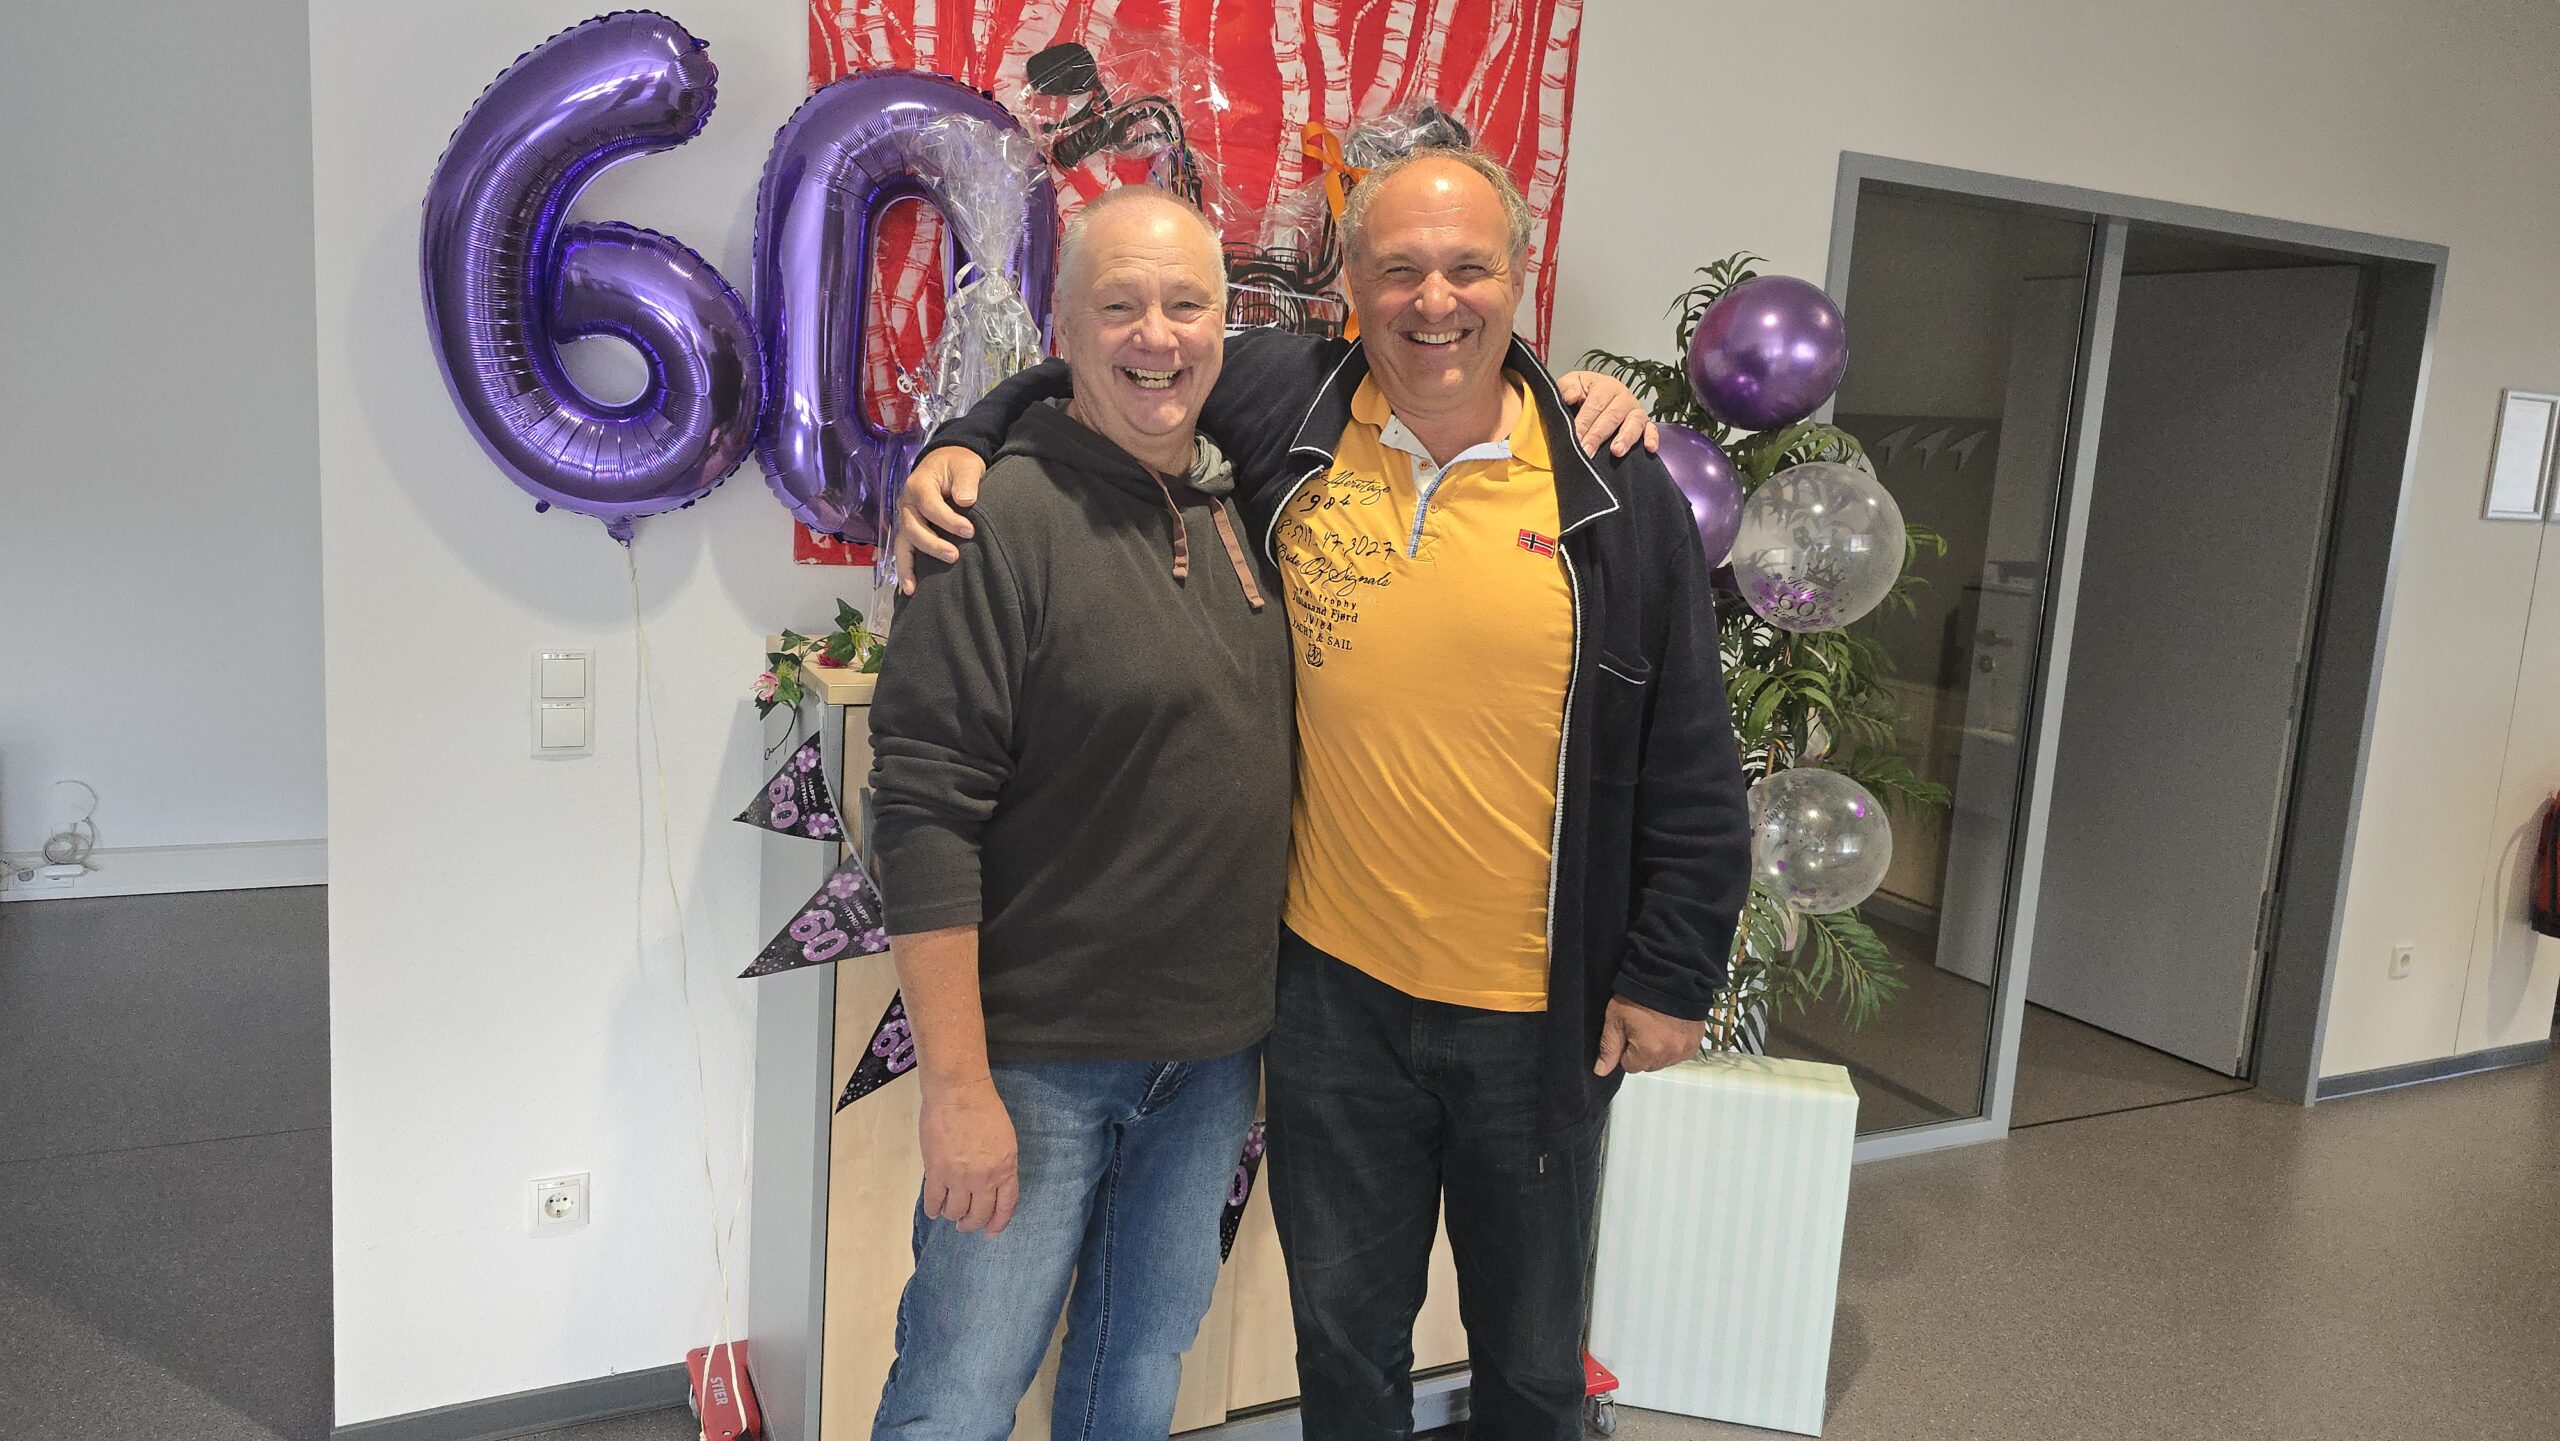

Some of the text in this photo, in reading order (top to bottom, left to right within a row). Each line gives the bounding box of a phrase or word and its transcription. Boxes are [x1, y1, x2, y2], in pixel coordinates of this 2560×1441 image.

[419, 12, 1058, 546] 60
[1297, 490, 1351, 512] 1984
[1321, 562, 1392, 597] Signals
[1318, 594, 1358, 610] trophy
[1778, 592, 1816, 617] 60
[1315, 633, 1324, 643] &
[1327, 636, 1353, 651] SAIL
[768, 775, 799, 829] 60
[808, 777, 818, 807] HAPPY
[853, 900, 872, 925] HAPPY
[789, 909, 849, 962] 60
[872, 1018, 916, 1073] 60
[710, 1376, 729, 1406] STIER
